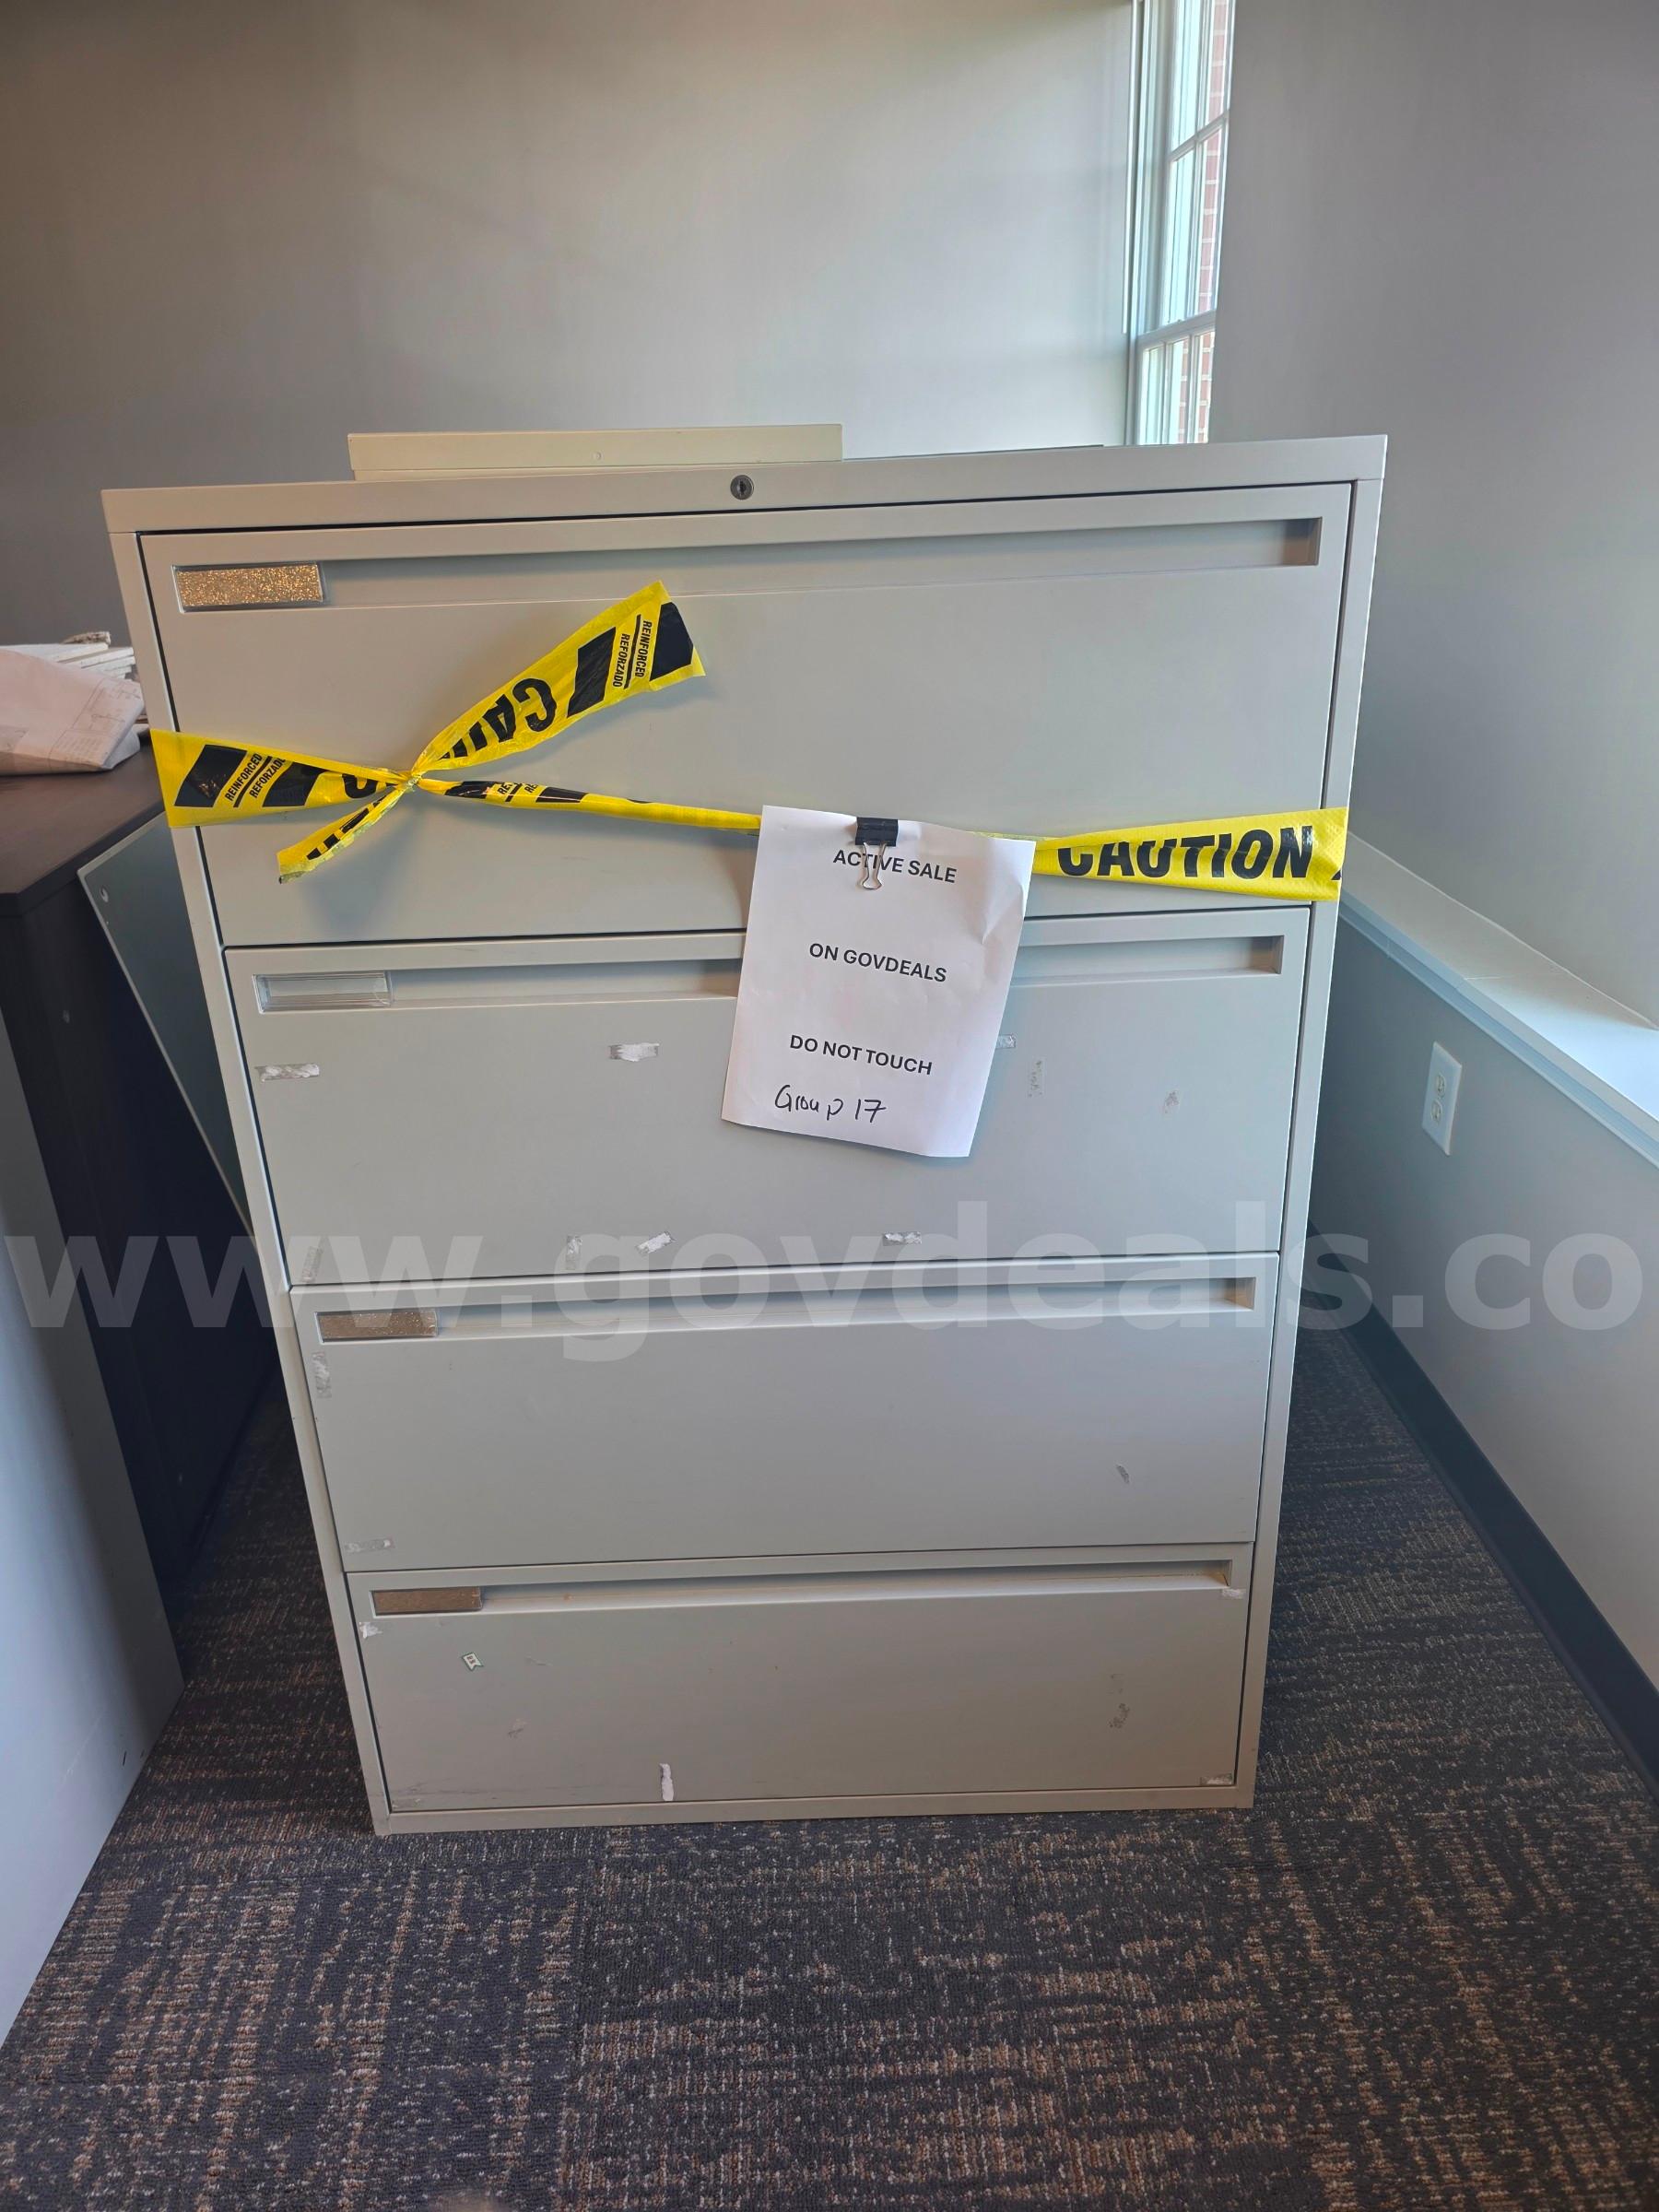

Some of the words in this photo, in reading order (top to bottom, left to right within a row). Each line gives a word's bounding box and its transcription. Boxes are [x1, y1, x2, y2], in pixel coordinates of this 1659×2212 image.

[612, 632, 630, 688] REFORZADO
[634, 619, 653, 678] REINFORCED
[224, 752, 264, 802] REINFORCED
[832, 849, 903, 873] ACTIVE
[908, 859, 958, 884] SALE
[1057, 825, 1313, 879] CAUTION
[808, 942, 839, 961] ON
[843, 949, 947, 982] GOVDEALS
[789, 1034, 818, 1053] DO
[822, 1041, 862, 1062] NOT
[865, 1049, 933, 1076] TOUCH
[774, 1084, 843, 1121] Group
[853, 1099, 887, 1123] 17
